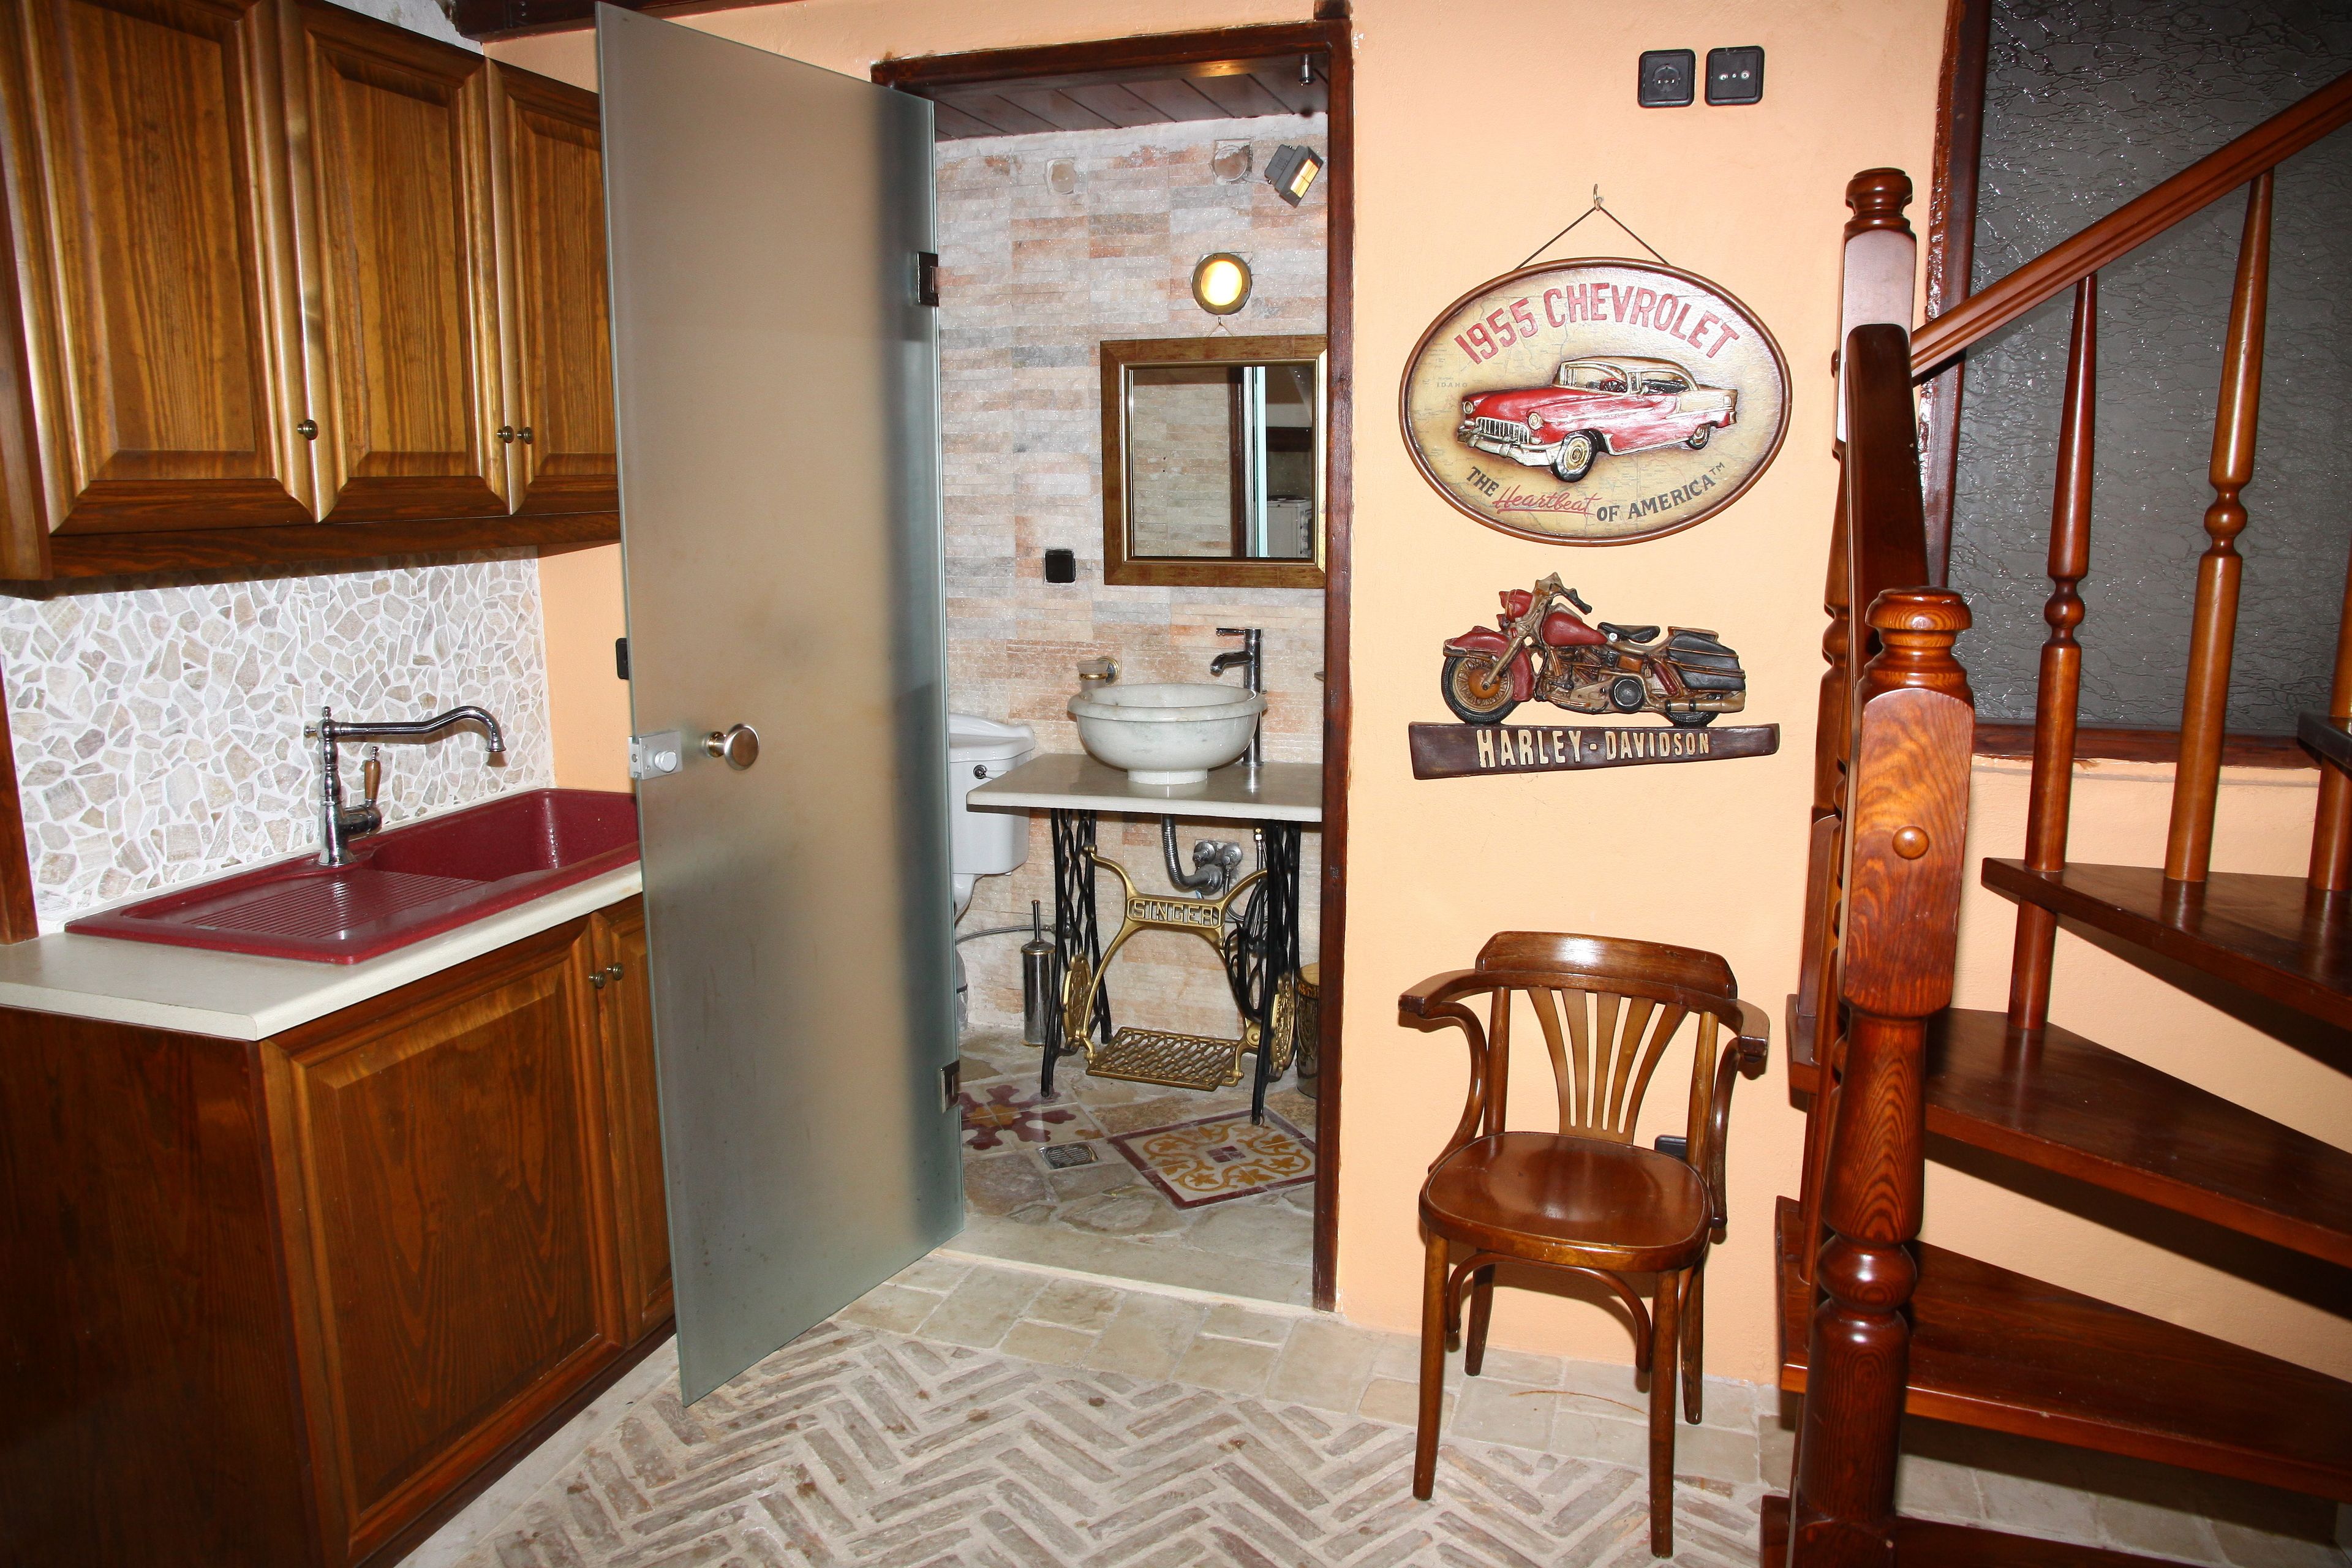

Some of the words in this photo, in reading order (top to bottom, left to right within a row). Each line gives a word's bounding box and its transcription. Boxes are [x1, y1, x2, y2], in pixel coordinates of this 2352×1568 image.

[1454, 298, 1538, 364] 1955
[1543, 282, 1740, 358] CHEVROLET
[1466, 466, 1500, 497] THE
[1492, 484, 1603, 519] Heartbeat
[1596, 505, 1620, 522] OF
[1133, 900, 1215, 926] SINGER
